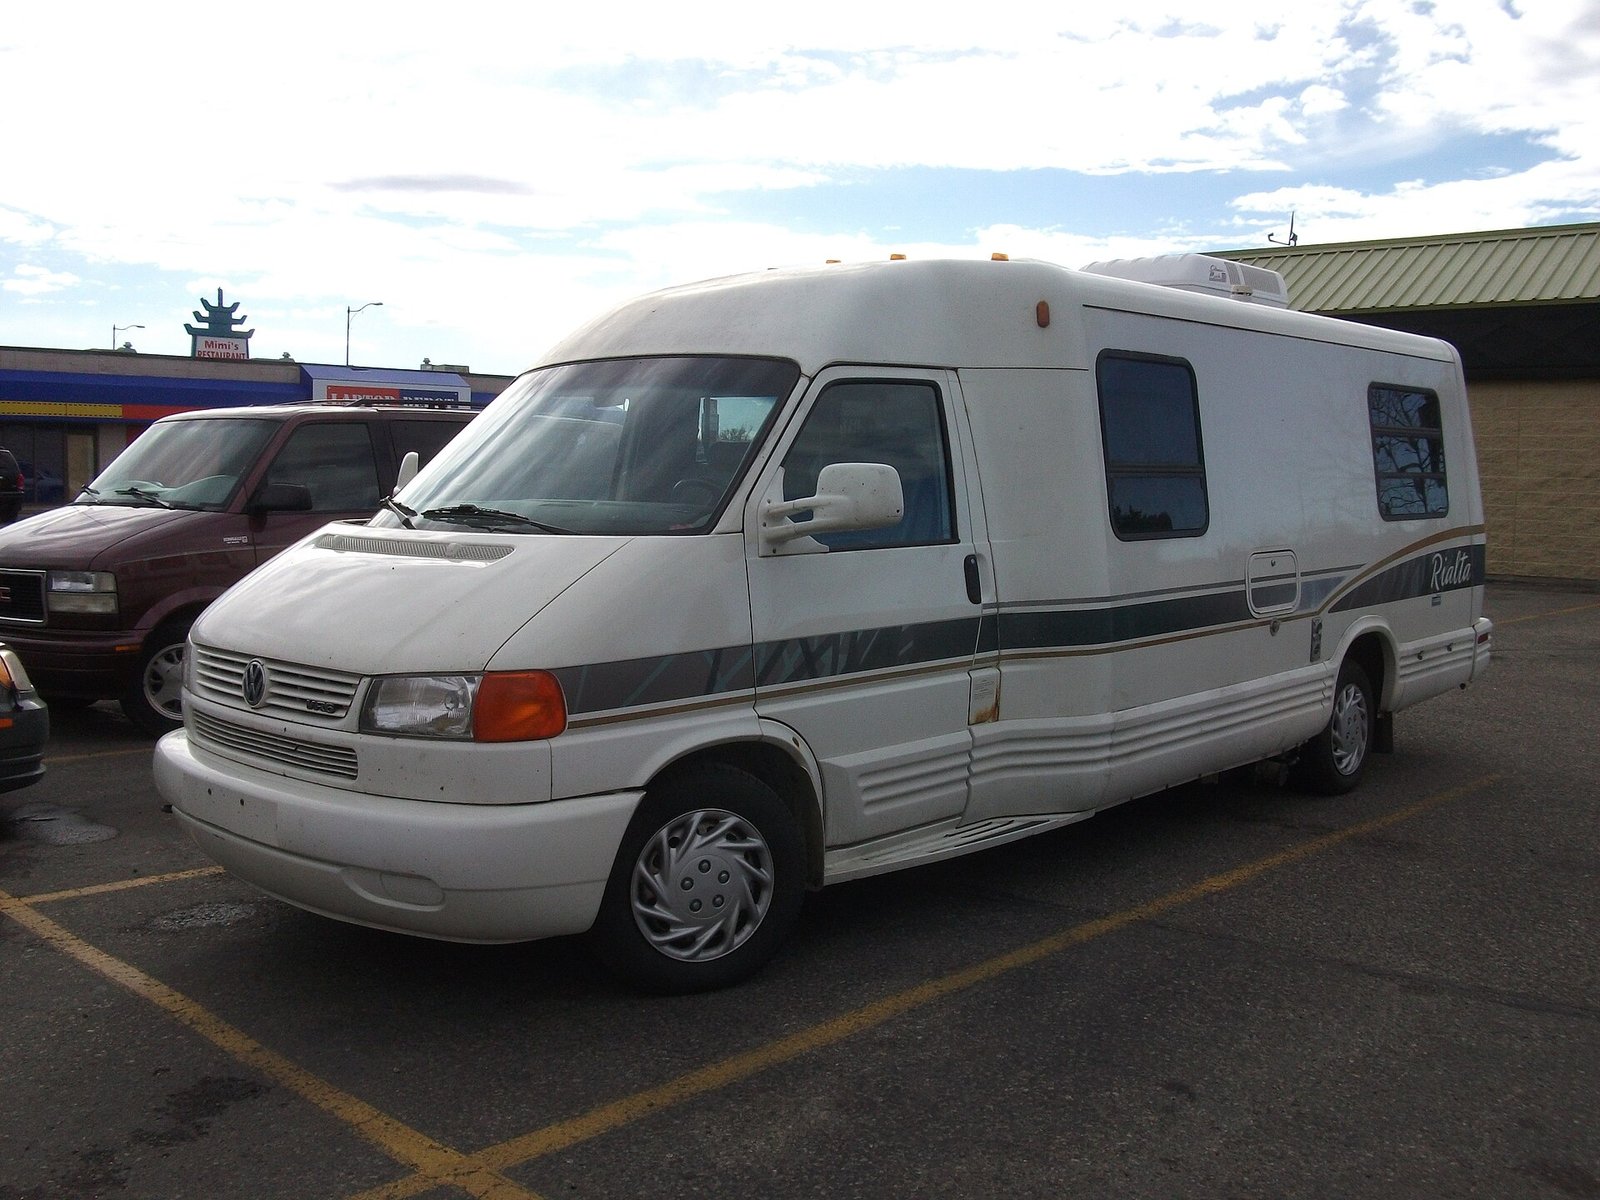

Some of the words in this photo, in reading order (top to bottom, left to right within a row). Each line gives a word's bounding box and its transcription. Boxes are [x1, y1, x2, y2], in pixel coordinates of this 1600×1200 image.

[204, 341, 239, 350] Mimi's
[197, 351, 246, 359] RESTAURANT
[1430, 551, 1471, 591] Rialta
